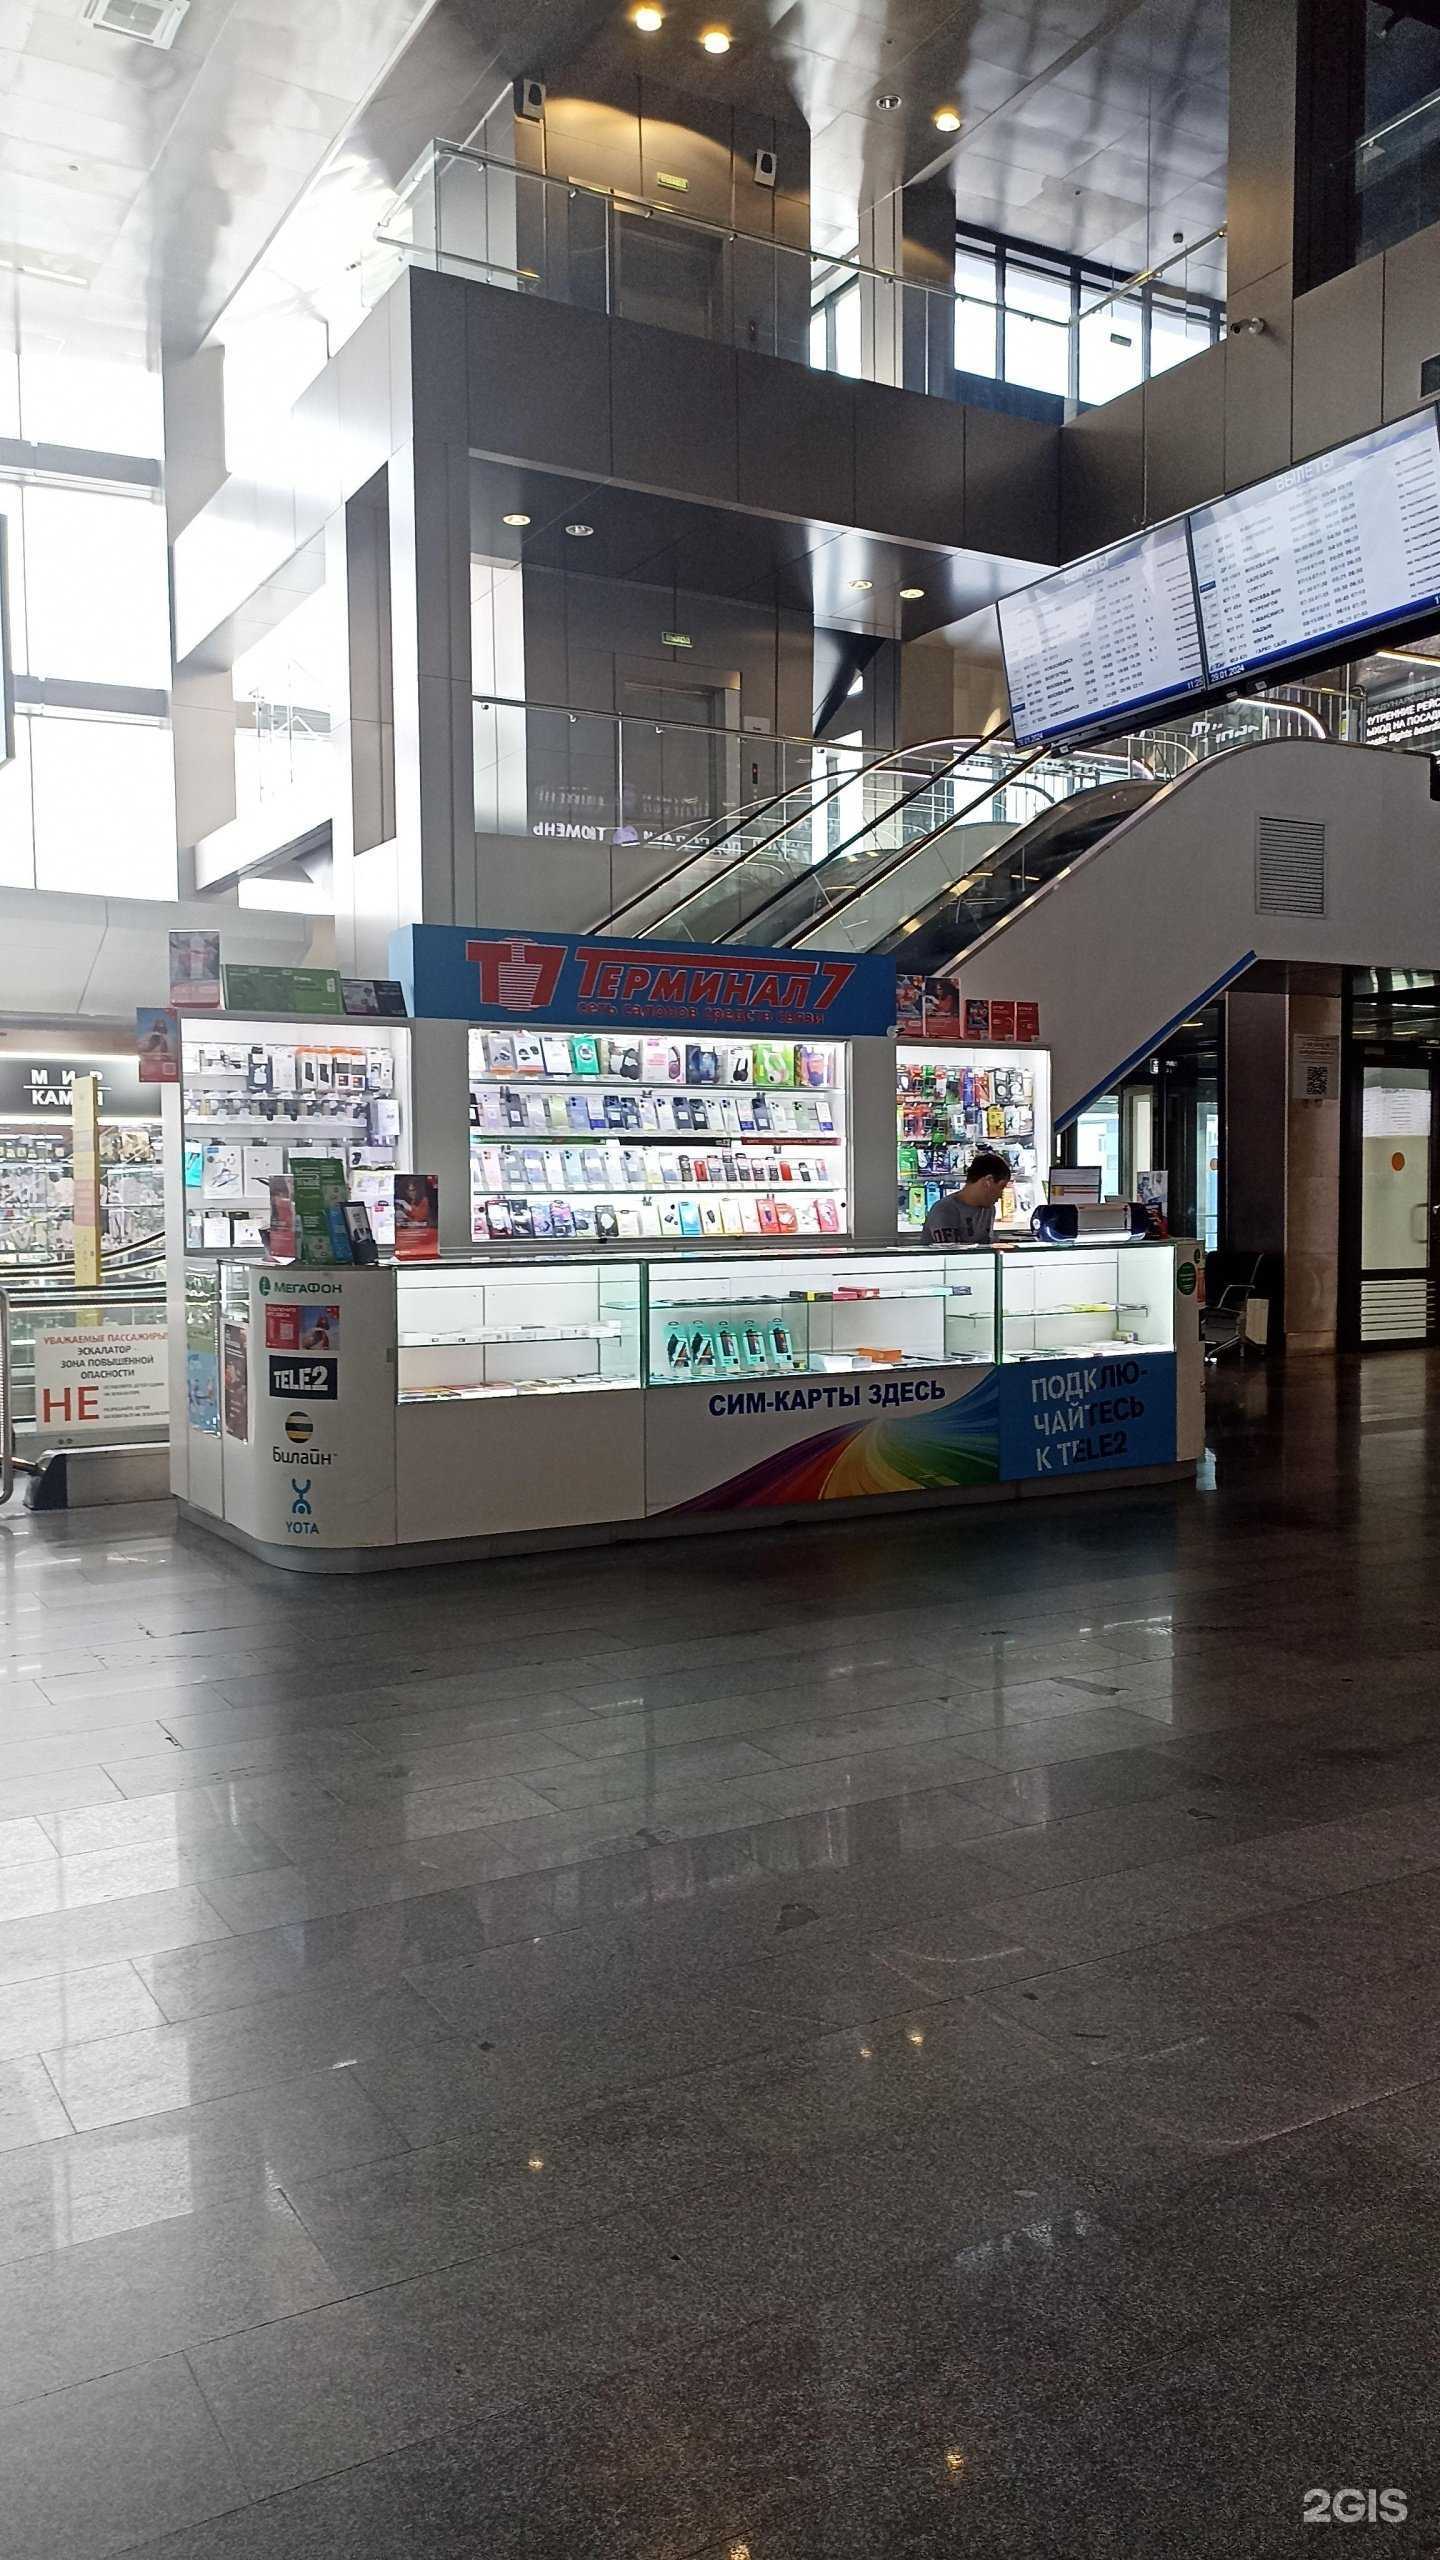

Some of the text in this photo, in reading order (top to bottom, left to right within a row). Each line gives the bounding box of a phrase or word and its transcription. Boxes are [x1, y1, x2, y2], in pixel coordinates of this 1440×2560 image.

[1366, 723, 1391, 737] ЫХОД
[1393, 719, 1405, 730] НА
[1389, 729, 1413, 743] flights
[32, 1090, 104, 1106] КАМ
[44, 1334, 105, 1345] УВАЖАЕМЫЕ
[77, 1346, 132, 1356] ЭСКАЛАТОР
[60, 1356, 154, 1369] ЗОНА ПОВЫШЕННОЙ
[80, 1369, 135, 1380] ОПАСНОСТИ
[273, 1365, 329, 1391] TELE2
[43, 1386, 100, 1423] НЕ
[708, 1379, 946, 1416] СИМ-КАРТЫ ЗДЕСЬ
[1033, 1396, 1145, 1436] ЧАЙТЕСЬ
[1036, 1430, 1128, 1471] К TELE2
[286, 1521, 320, 1535] YOTA
